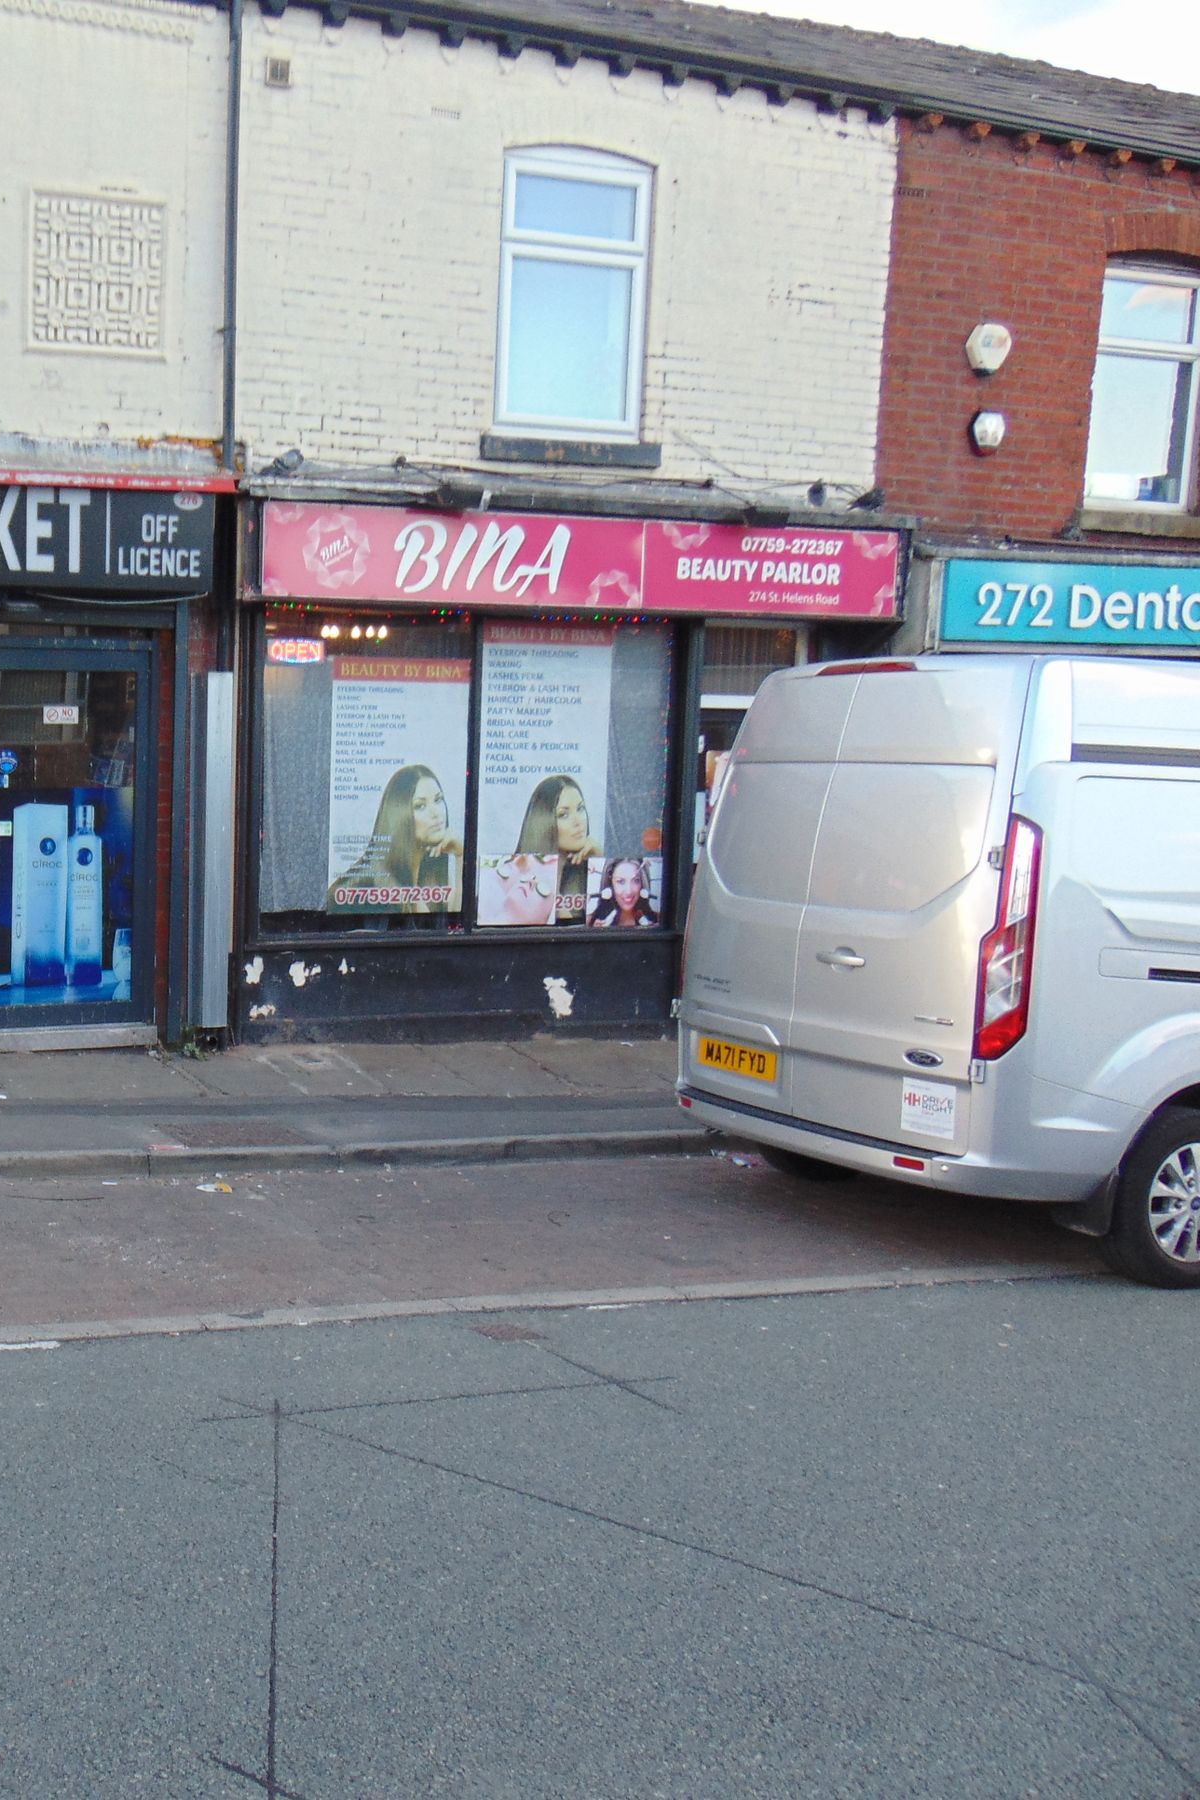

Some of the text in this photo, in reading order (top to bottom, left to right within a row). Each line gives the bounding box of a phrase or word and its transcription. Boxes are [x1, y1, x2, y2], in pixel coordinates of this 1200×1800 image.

[180, 494, 198, 506] 276
[141, 513, 179, 543] OFF
[320, 534, 350, 561] BINA
[741, 536, 843, 556] 07759-272367
[118, 546, 201, 578] LICENCE
[394, 520, 571, 598] BINA
[676, 556, 841, 586] BEAUTY PARLOR
[749, 591, 766, 603] 274
[782, 593, 814, 604] Helens
[815, 594, 839, 605] Road
[977, 581, 1054, 627] 272
[271, 642, 320, 658] OPEN
[341, 662, 462, 678] BEAUTY BY BINA
[335, 886, 452, 905] 07759272367
[922, 1102, 953, 1114] RIGHT
